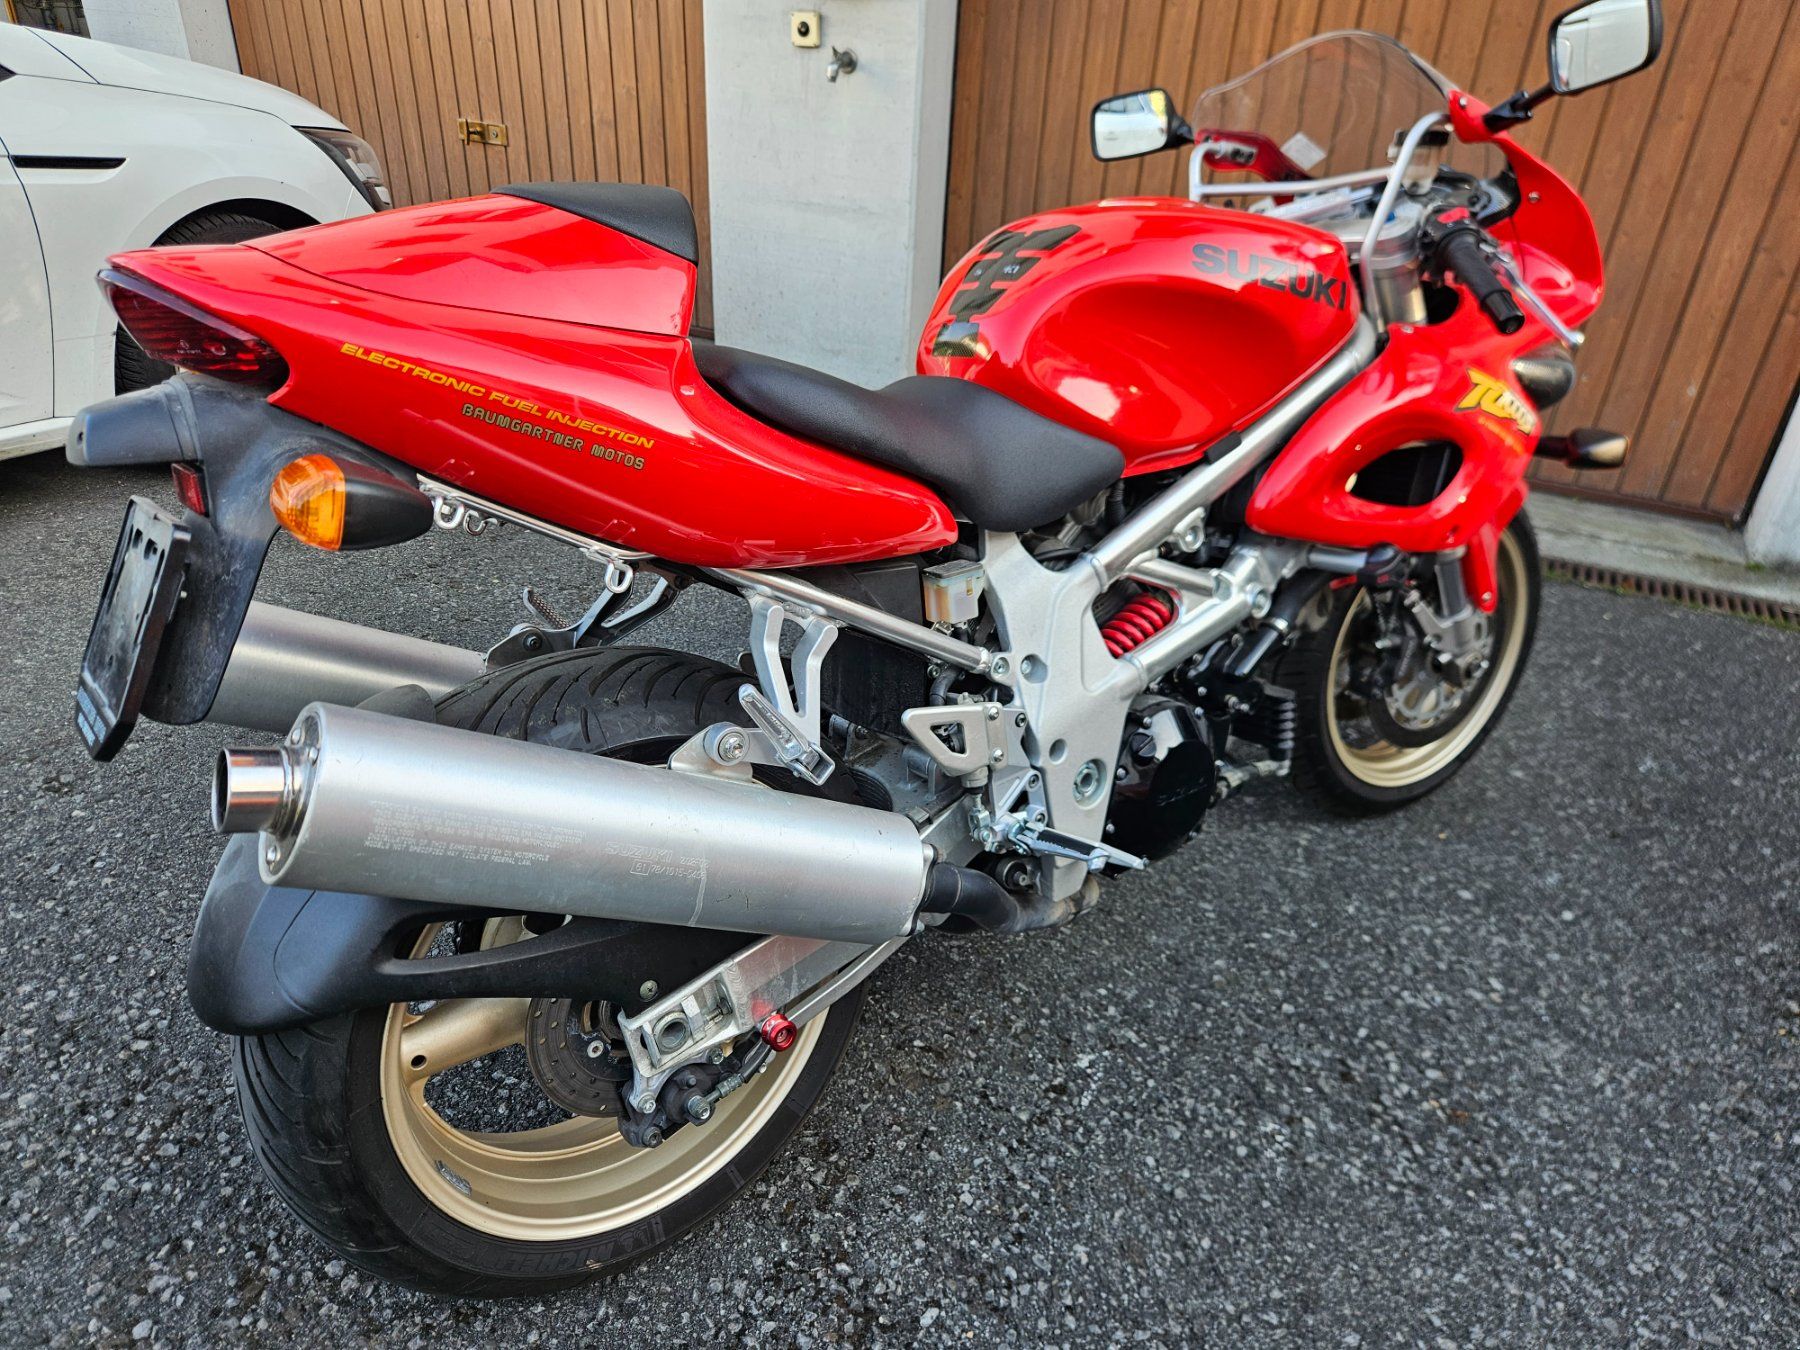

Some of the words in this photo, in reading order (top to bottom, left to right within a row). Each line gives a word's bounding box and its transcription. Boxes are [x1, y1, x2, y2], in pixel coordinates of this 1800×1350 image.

[1191, 242, 1348, 312] SUZUKI
[339, 342, 486, 398] ELECTRONIC
[488, 391, 543, 417] FUEL
[545, 409, 655, 450] INJECTION
[462, 403, 585, 452] BAUMGARTNER
[590, 443, 646, 471] MOTOS
